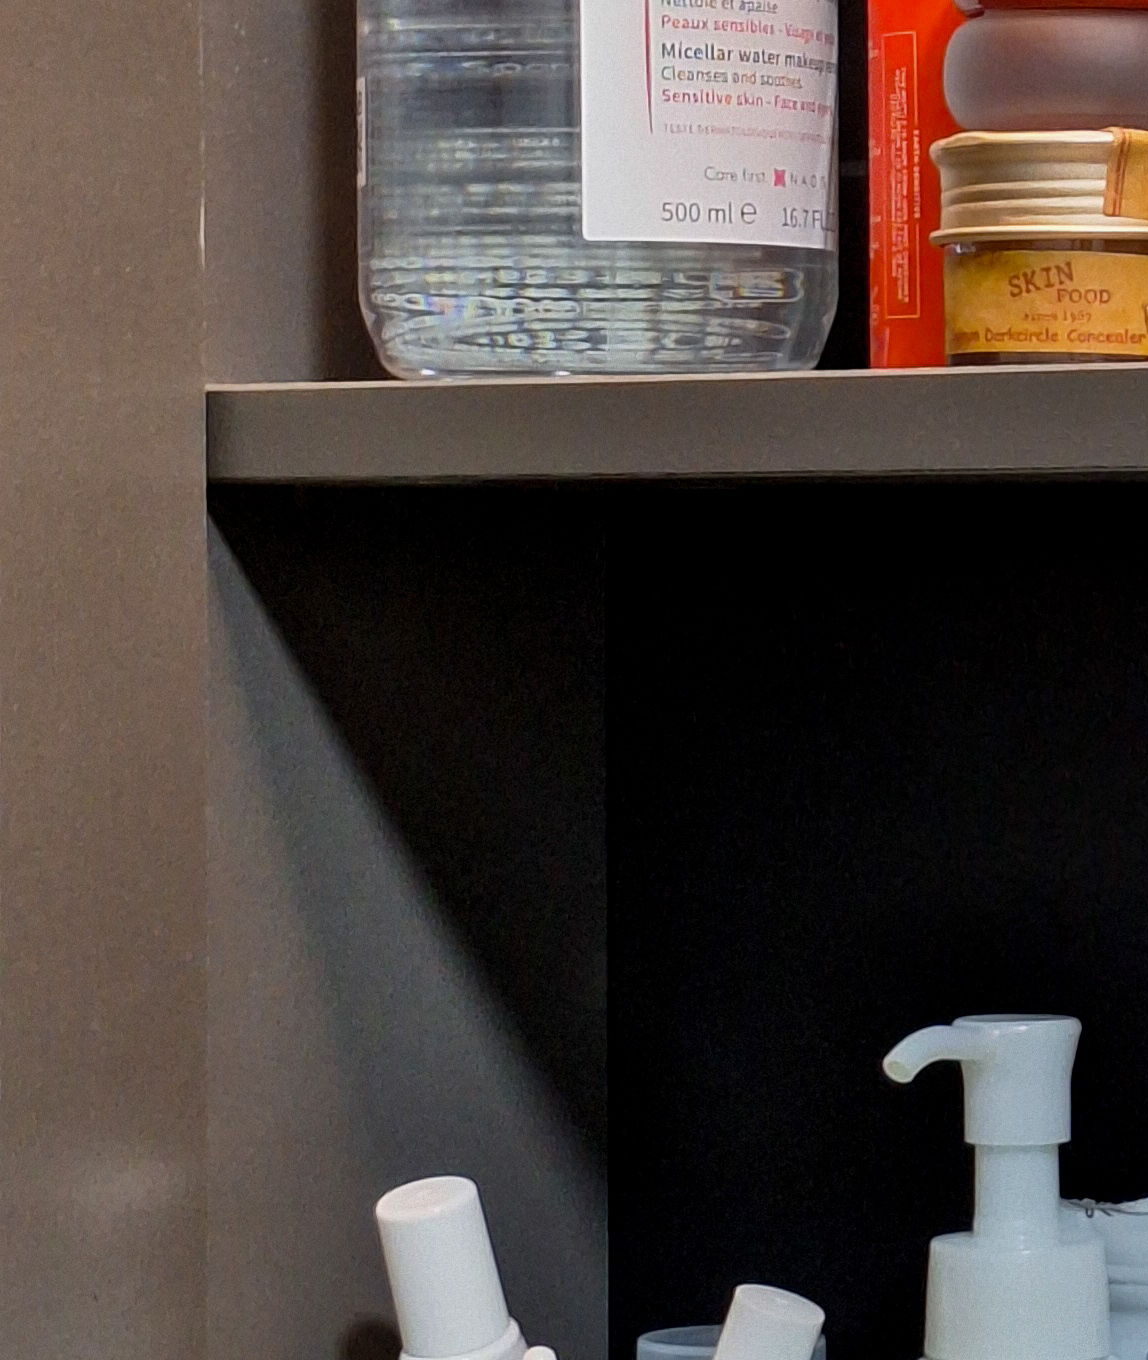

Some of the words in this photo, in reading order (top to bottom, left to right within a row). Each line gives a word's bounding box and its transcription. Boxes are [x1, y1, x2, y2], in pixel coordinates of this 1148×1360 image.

[661, 14, 709, 30] Peaux
[713, 19, 776, 36] sensibles
[661, 42, 734, 61] Micellar
[738, 47, 781, 67] water
[661, 65, 729, 83] Cleanses
[732, 70, 757, 85] and
[661, 88, 732, 106] Sensitive
[736, 92, 764, 108] skin
[661, 202, 701, 222] 500
[708, 201, 733, 224] ml
[1008, 261, 1075, 298] SKIN
[1057, 288, 1111, 304] FOOD
[984, 327, 1059, 344] Darkcircle
[1066, 329, 1146, 346] Concealer
